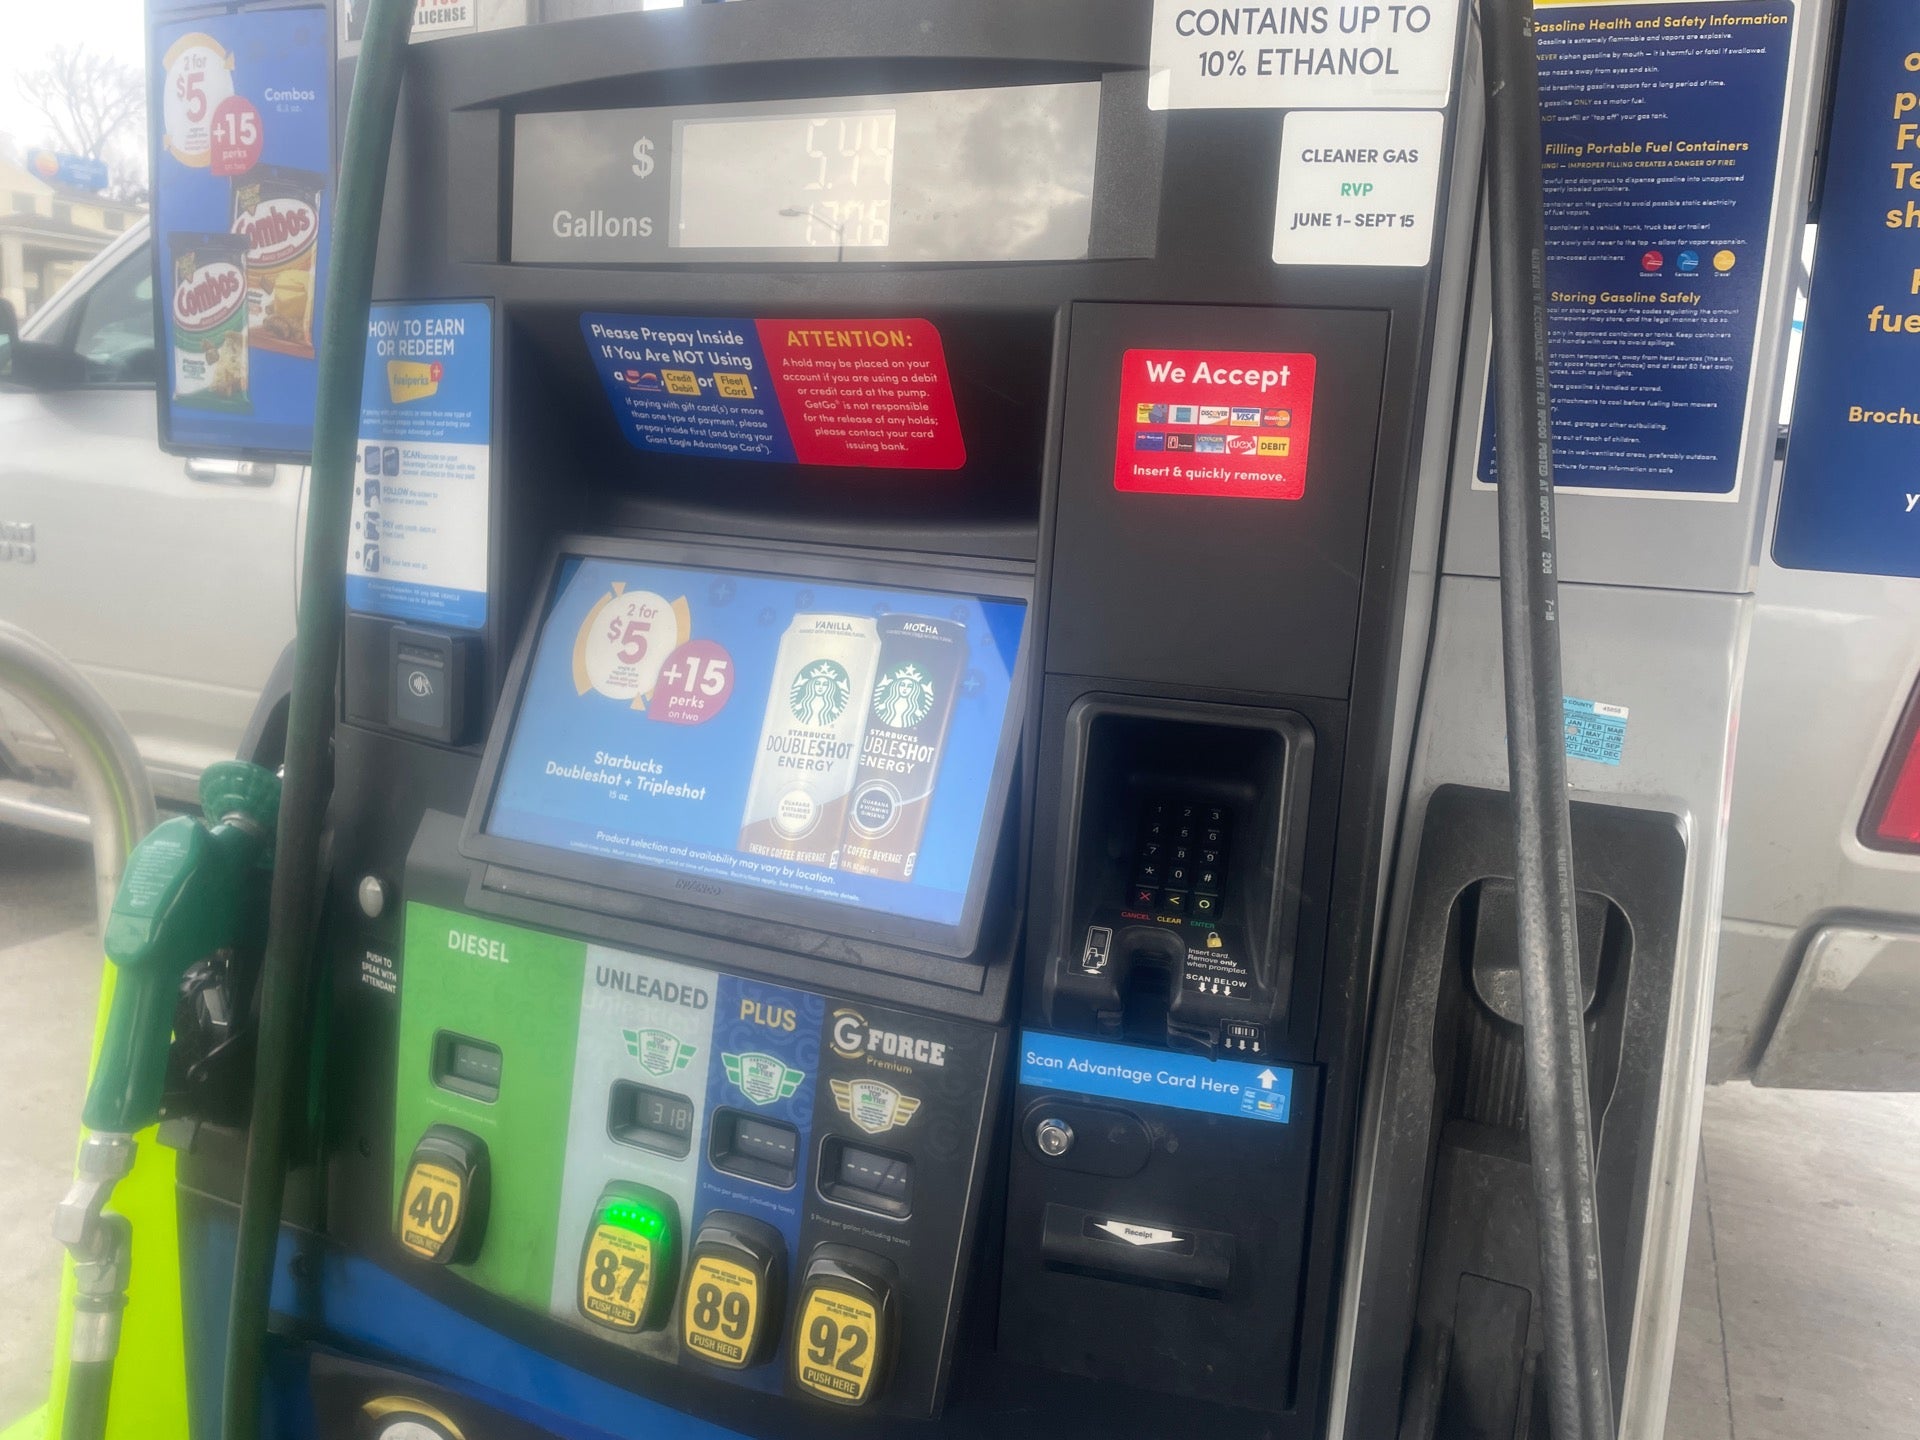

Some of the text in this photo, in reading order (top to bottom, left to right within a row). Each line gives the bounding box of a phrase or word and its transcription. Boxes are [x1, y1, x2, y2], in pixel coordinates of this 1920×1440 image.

[419, 8, 466, 24] LICENSE
[1176, 5, 1430, 36] CONTAINS UP TO
[1590, 18, 1631, 30] Health
[1636, 17, 1660, 28] and
[1664, 15, 1706, 29] Safety
[1710, 14, 1788, 25] Information
[1538, 38, 1566, 46] Gasoline
[1574, 36, 1607, 45] extremely
[1608, 35, 1645, 43] flammable
[1661, 34, 1685, 42] vapors
[184, 55, 206, 70] 2 for
[1199, 48, 1399, 76] 10% ETHANOL
[176, 72, 207, 122] $5
[265, 88, 315, 101] Combos
[213, 112, 257, 145] +15
[223, 150, 247, 160] perks
[803, 117, 895, 190] 5.44
[1302, 150, 1418, 162] CLEANER GAS
[1545, 141, 1749, 156] Filling Portable Fuel Containers
[632, 136, 655, 178] $
[1340, 183, 1374, 196] RVP
[553, 209, 653, 239] Gallons
[1290, 213, 1332, 230] JUNE
[1355, 214, 1396, 227] SEPT
[1400, 216, 1414, 227] 15
[178, 270, 239, 317] Combos
[1551, 292, 1700, 305] Storing Gasoline Safely
[369, 319, 464, 337] HOW TO EARN
[591, 324, 743, 346] Please Prepay Inside
[787, 331, 913, 347] ATTENTION:
[377, 339, 454, 356] OR REDEEM
[602, 345, 752, 369] If You Are NOT Using
[782, 358, 790, 366] A
[791, 359, 812, 367] hold
[815, 360, 836, 369] may
[839, 359, 851, 368] be
[855, 360, 889, 369] placed
[907, 360, 929, 369] your
[614, 371, 624, 381] a
[666, 373, 692, 383] Credit
[699, 376, 713, 387] or
[721, 375, 743, 386] Fleet
[1146, 360, 1290, 392] We Accept
[671, 383, 694, 393] Debit
[724, 387, 747, 397] Card
[1230, 440, 1253, 449] wex
[1261, 442, 1287, 451] DEBIT
[1133, 465, 1286, 482] Insert & quickly remove.
[627, 603, 658, 619] 2 for
[815, 621, 852, 631] VANILLA
[903, 622, 938, 635] MOCHA
[607, 616, 651, 665] $5
[663, 656, 727, 696] +15
[669, 695, 705, 709] perks
[1568, 719, 1582, 727] JAN
[788, 730, 835, 739] STARBUCKS
[870, 729, 918, 742] STARBUCKS
[766, 735, 853, 760] DOUBLESHOT
[594, 751, 663, 774] Starbucks
[778, 756, 834, 771] ENERGY
[546, 761, 706, 800] Doubleshot + Tripleshot
[596, 831, 629, 845] Product
[631, 839, 668, 852] selection
[670, 846, 688, 856] and
[689, 849, 737, 867] availability
[739, 860, 759, 871] may
[760, 865, 781, 876] vary
[782, 866, 794, 878] by
[796, 868, 835, 885] location.
[1121, 911, 1151, 921] CANCEL
[1157, 916, 1181, 925] CLEAR
[1190, 920, 1215, 929] ENTER
[448, 930, 509, 963] DIESEL
[1189, 948, 1209, 957] Insert
[366, 952, 392, 968] PUSH TO
[1187, 961, 1248, 975] when prompted.
[1188, 955, 1237, 968] Remove only
[362, 962, 396, 982] SPEAK WITH
[362, 974, 396, 994] ATTENDANT
[595, 965, 709, 1010] UNLEADED
[1186, 973, 1247, 988] SCAN BELOW
[740, 999, 796, 1032] PLUS
[834, 1017, 946, 1066] G FORCE
[867, 1056, 912, 1075] Premium
[1026, 1052, 1063, 1070] Scan
[1067, 1058, 1152, 1084] Advantage
[1157, 1071, 1195, 1088] Card
[1201, 1078, 1240, 1095] Here
[408, 1186, 453, 1235] 40
[1125, 1228, 1153, 1239] Receipt
[591, 1249, 646, 1303] 87
[693, 1283, 750, 1340] 89
[808, 1316, 868, 1377] 92
[808, 1370, 855, 1393] PUSH HERE
